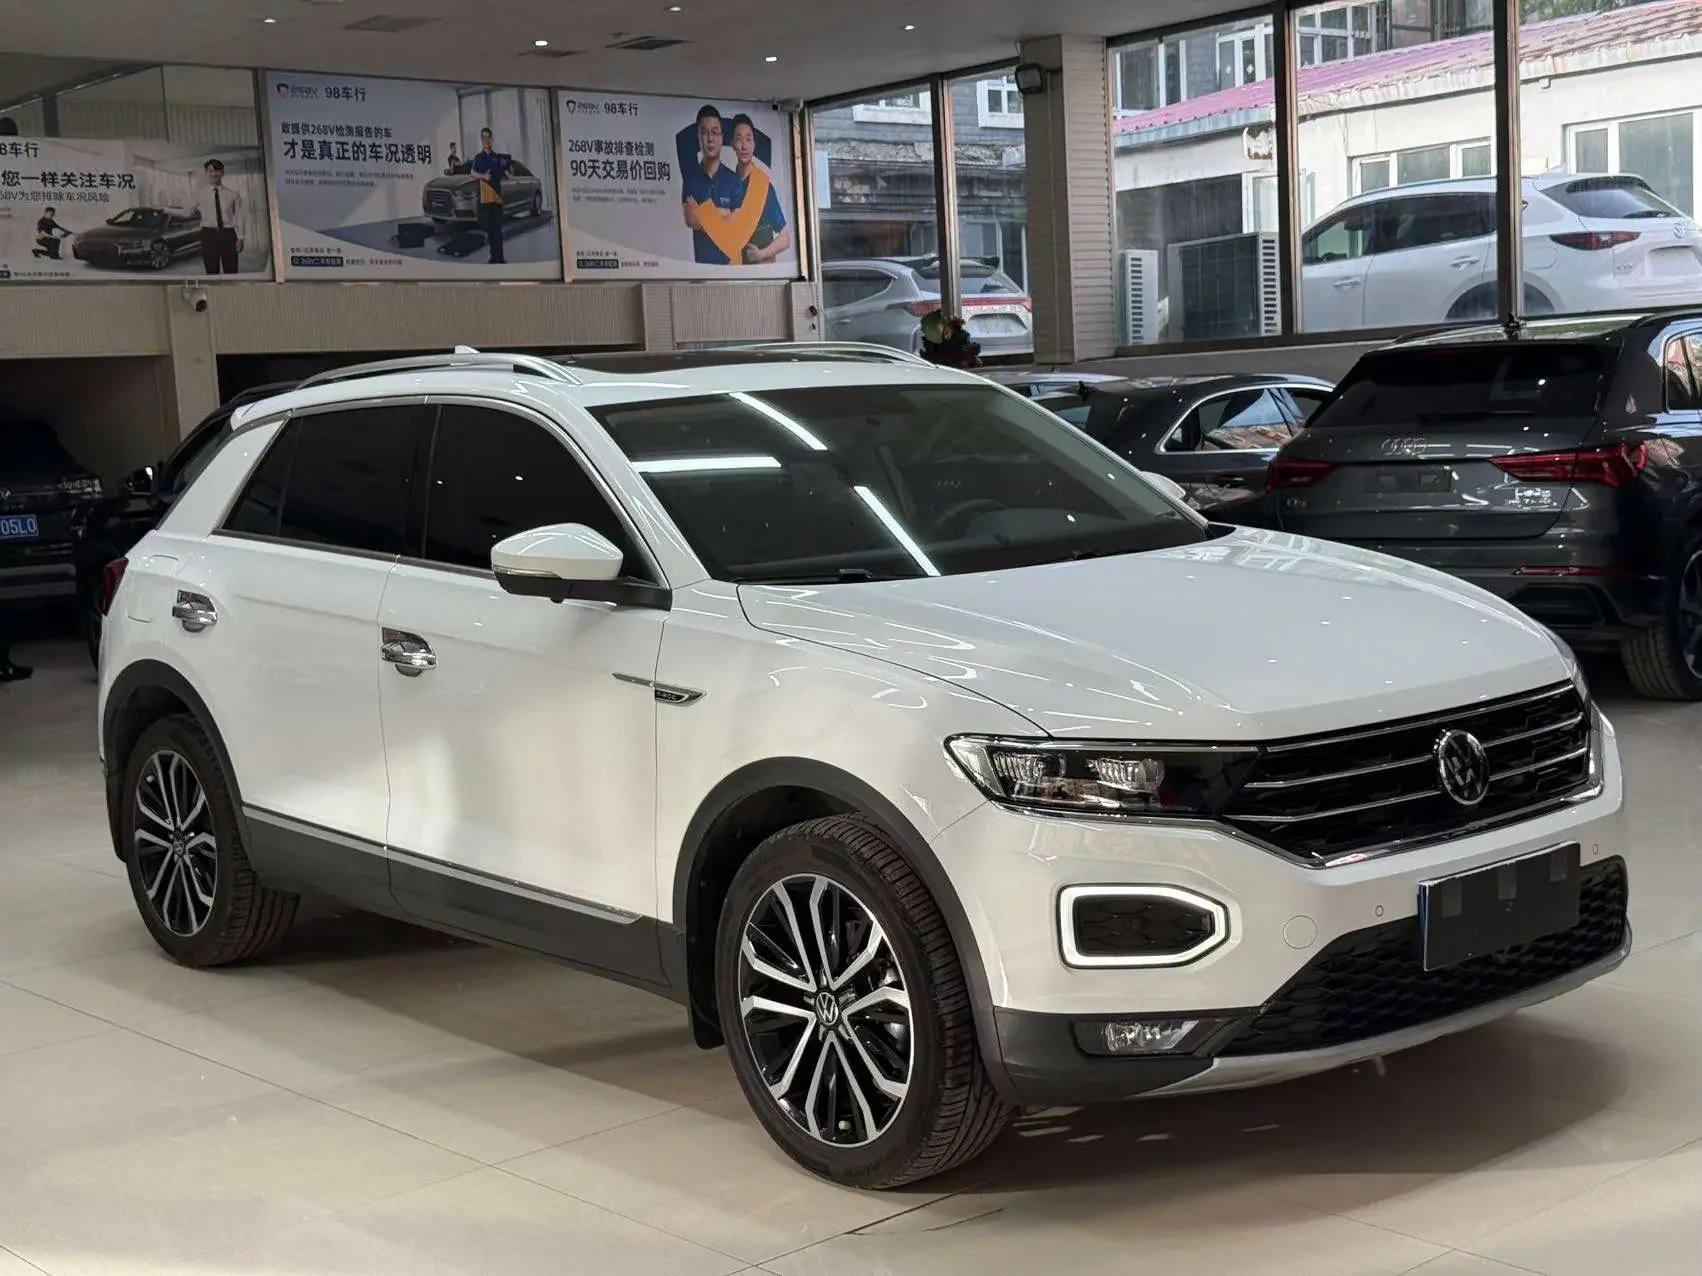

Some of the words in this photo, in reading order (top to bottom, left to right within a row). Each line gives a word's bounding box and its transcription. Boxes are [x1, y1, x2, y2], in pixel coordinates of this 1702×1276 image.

[324, 85, 366, 102] 98车行
[604, 102, 639, 117] 98车行
[283, 139, 432, 165] 才是真正的车况透明
[570, 159, 671, 181] 90天交易价回购
